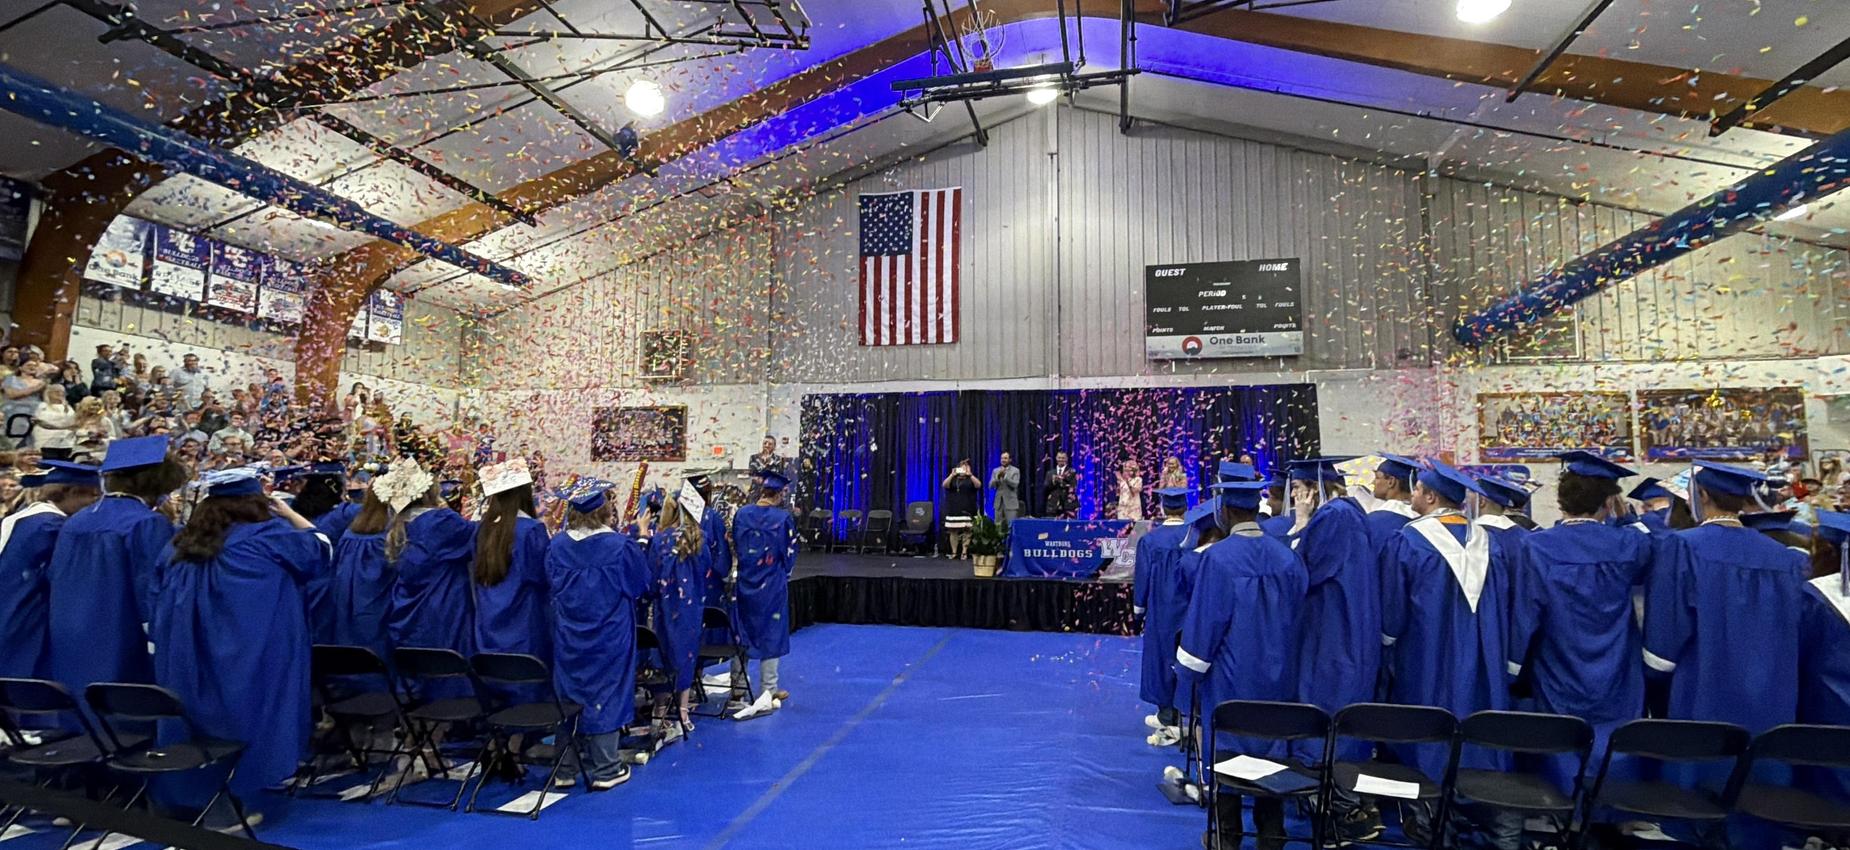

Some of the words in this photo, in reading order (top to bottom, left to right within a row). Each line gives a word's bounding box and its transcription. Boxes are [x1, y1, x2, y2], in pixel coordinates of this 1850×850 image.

[1154, 267, 1186, 277] GUEST
[1258, 262, 1289, 272] HOME
[1198, 289, 1227, 297] PERIOD
[1201, 303, 1243, 311] PLAYER-FOUL
[1209, 336, 1234, 345] One
[1235, 334, 1265, 344] Bank
[1023, 548, 1093, 558] BULLDOGS
